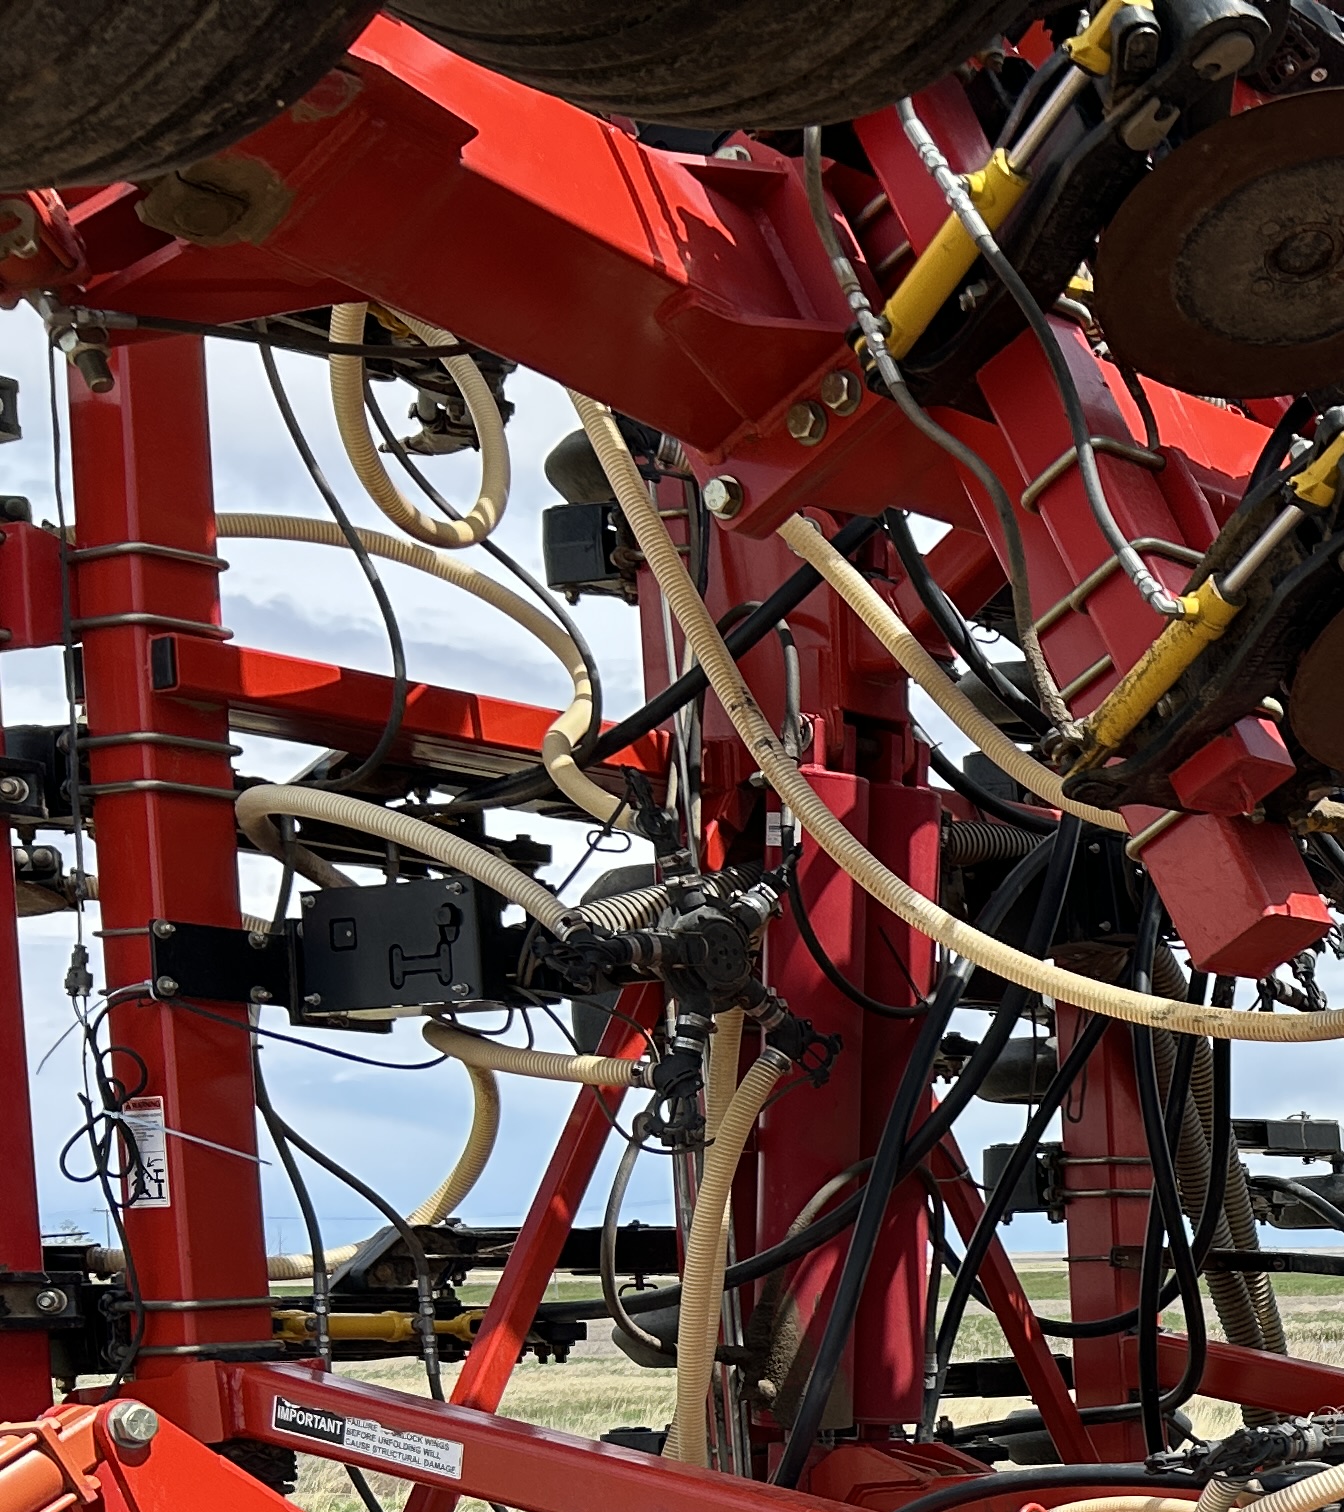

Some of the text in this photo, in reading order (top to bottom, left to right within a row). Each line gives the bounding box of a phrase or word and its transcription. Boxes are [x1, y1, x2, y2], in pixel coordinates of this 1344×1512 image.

[277, 1404, 343, 1436] IMPORTANT
[345, 1427, 376, 1443] BEFORE
[378, 1435, 421, 1455] UNFOLDING
[423, 1448, 440, 1460] WILL
[345, 1437, 456, 1474] CAUSE STRUCTURAL DAMAGE
[424, 1437, 450, 1451] WINGS
